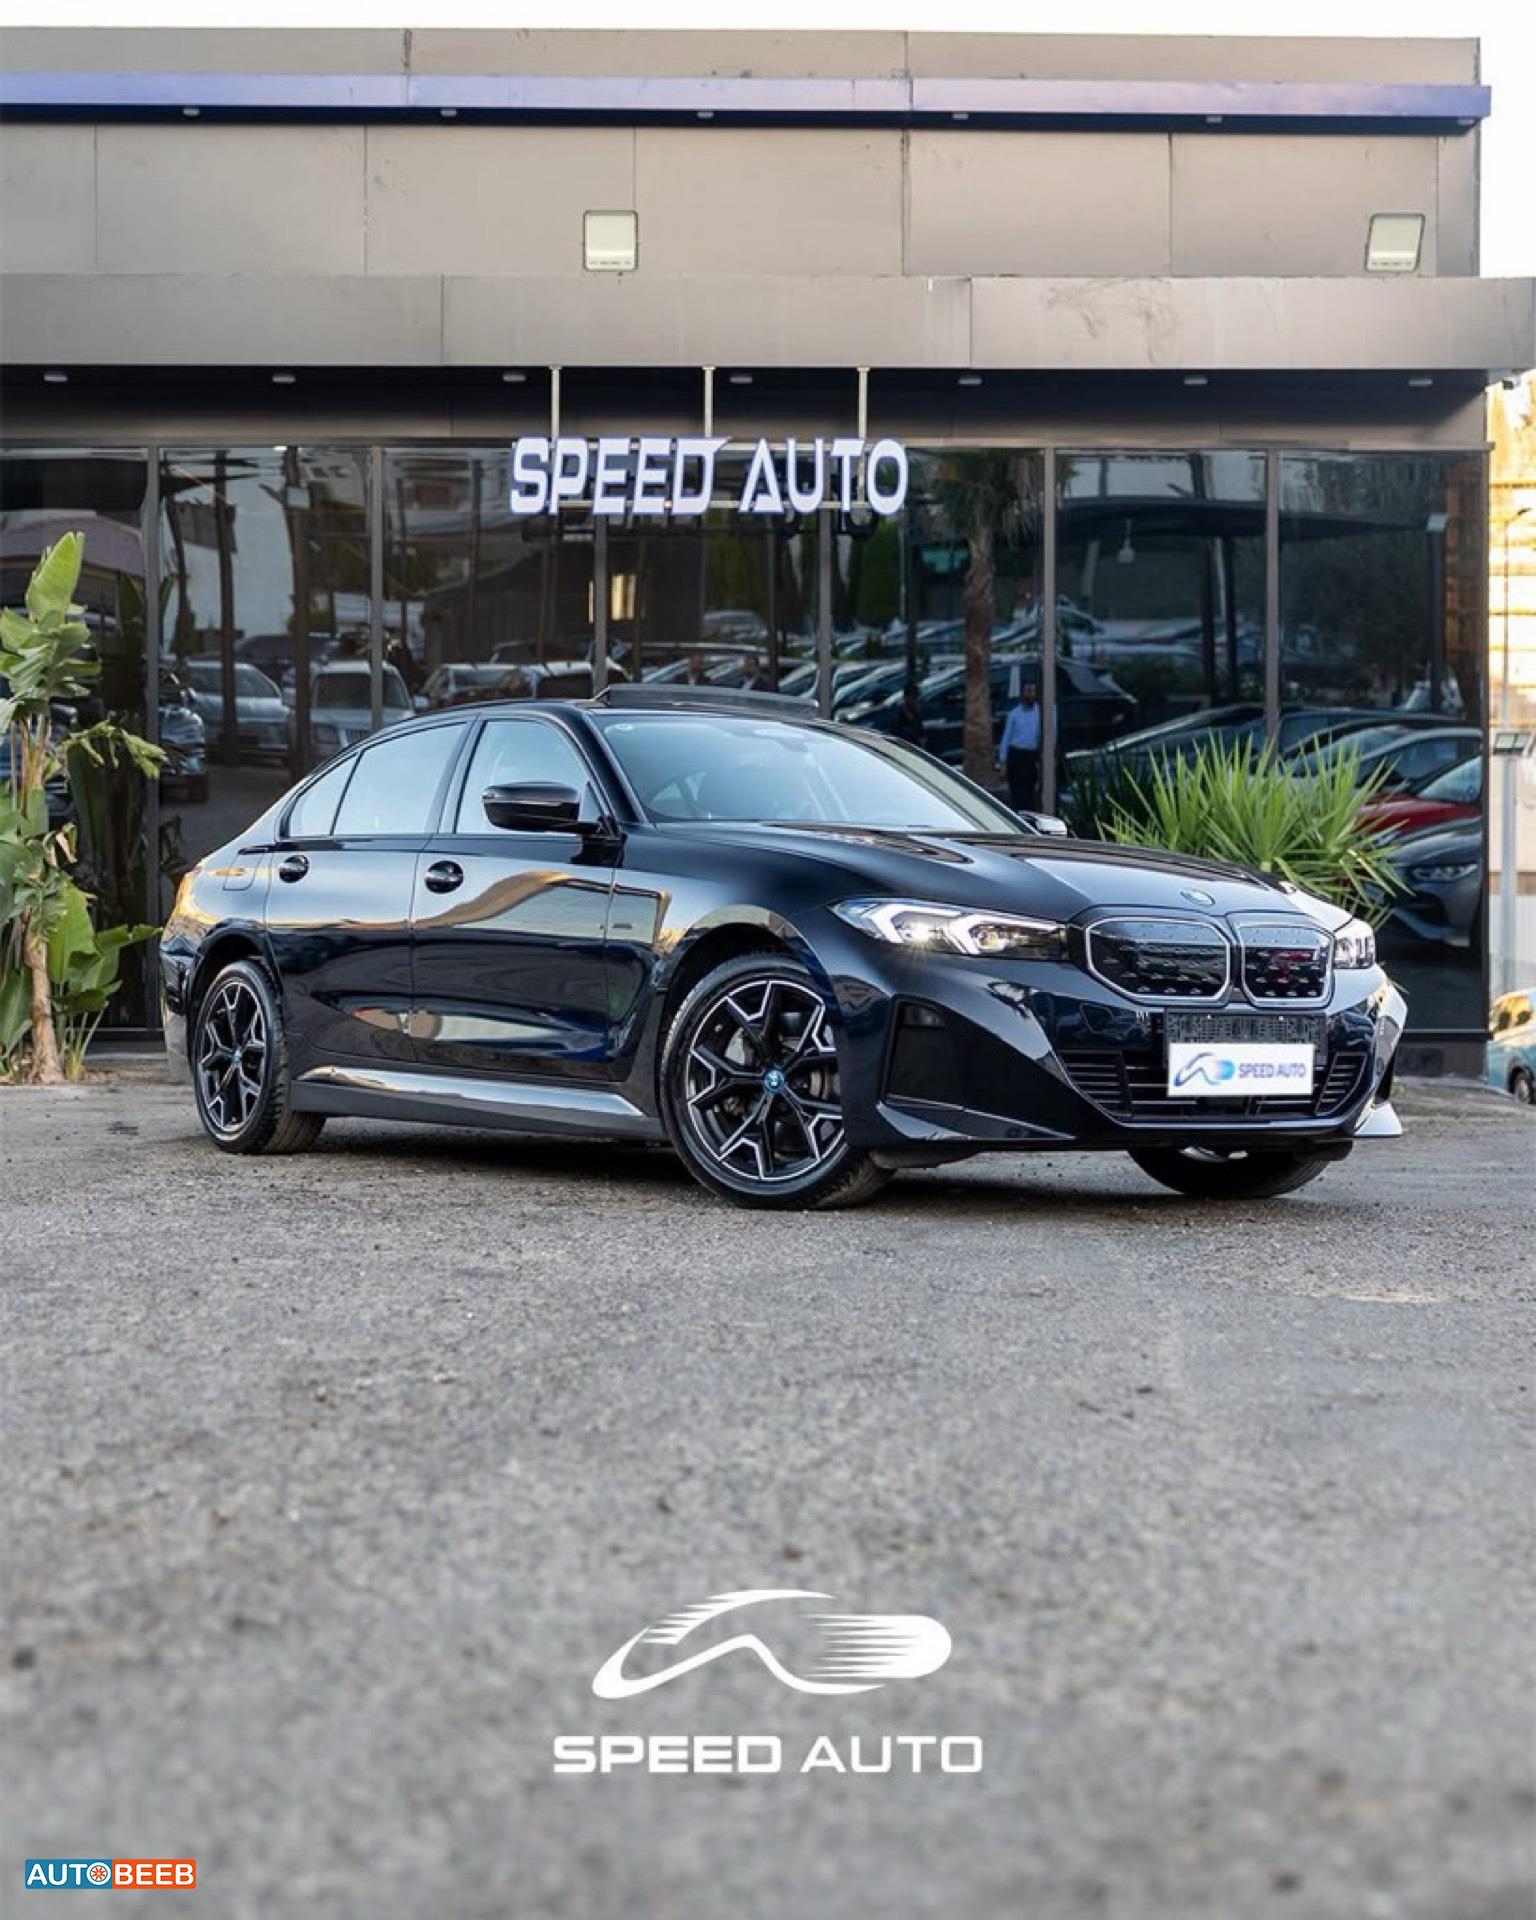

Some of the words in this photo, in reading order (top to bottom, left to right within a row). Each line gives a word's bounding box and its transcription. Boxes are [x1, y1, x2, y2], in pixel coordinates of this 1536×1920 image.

[510, 436, 732, 514] SPEED
[738, 437, 908, 515] AUTO
[1239, 1062, 1274, 1078] SPEED
[1276, 1062, 1306, 1078] AUTO
